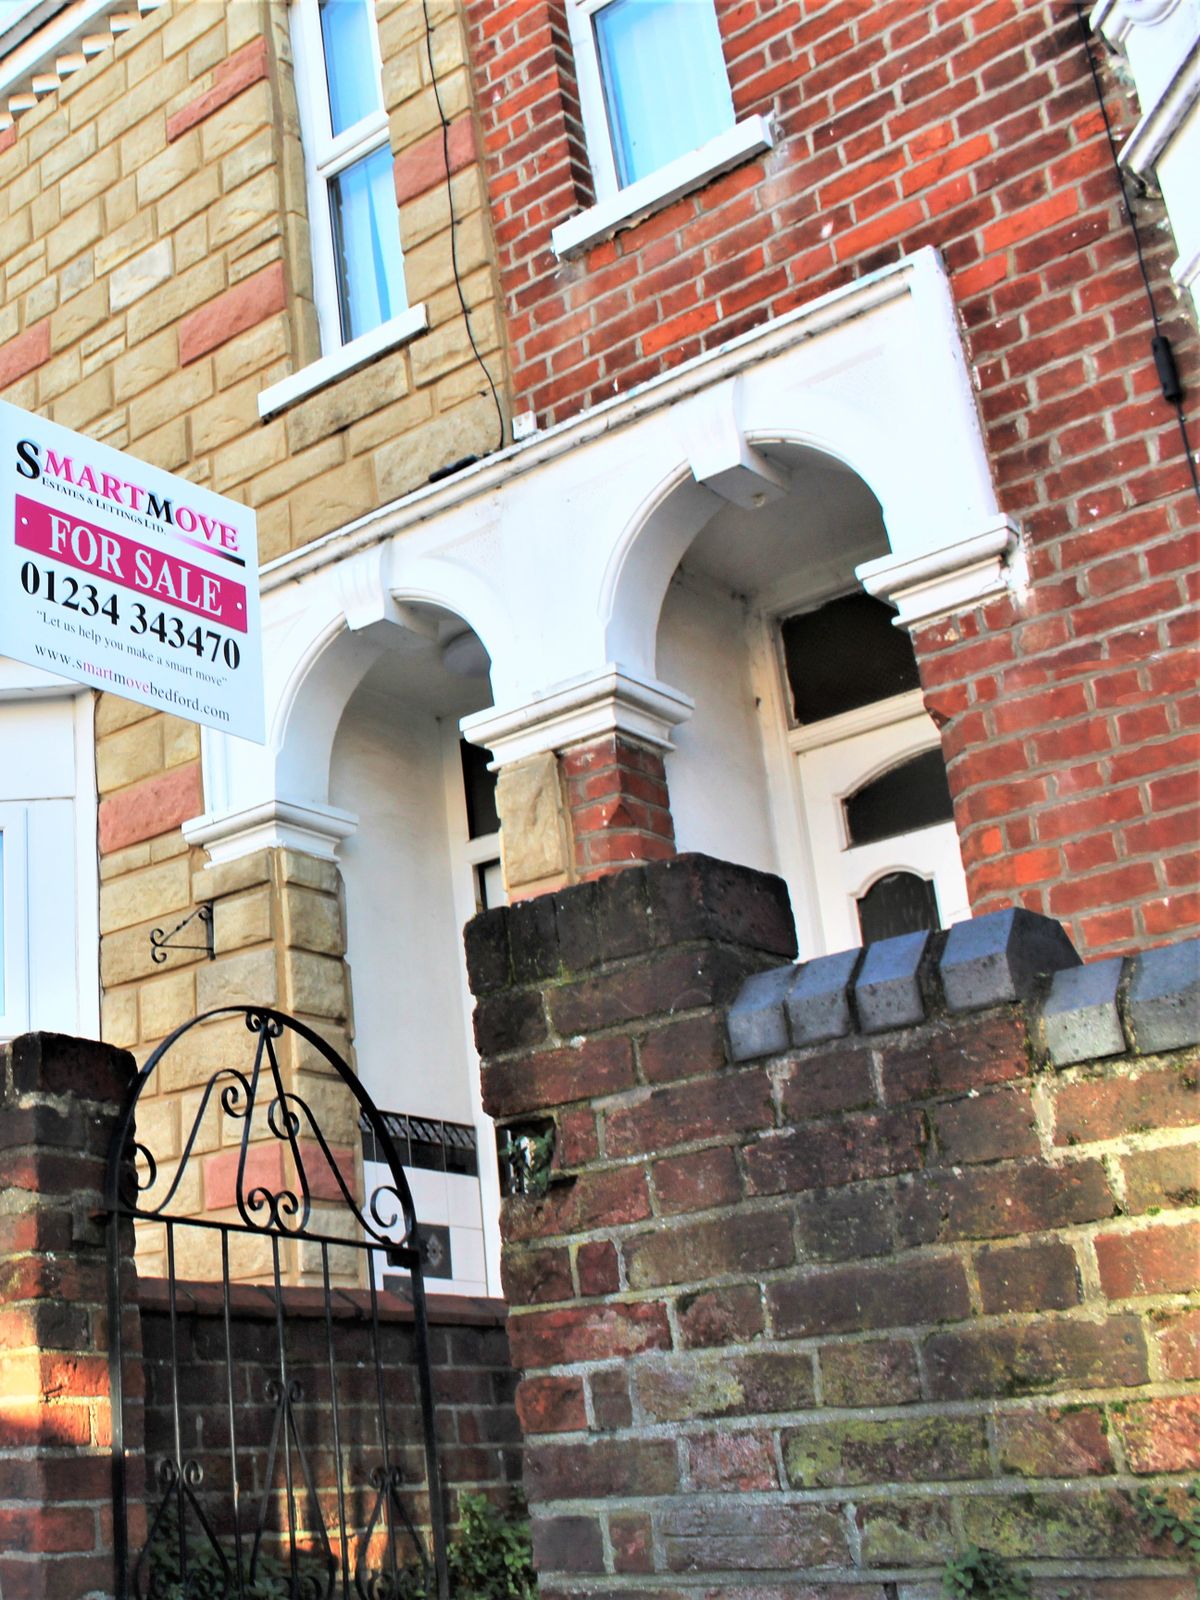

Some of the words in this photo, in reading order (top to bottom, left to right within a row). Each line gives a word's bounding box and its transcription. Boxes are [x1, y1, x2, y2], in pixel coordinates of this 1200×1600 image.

[16, 440, 239, 552] SMARTMOVE
[42, 477, 85, 502] ESTATES
[86, 497, 94, 506] &
[96, 499, 143, 525] LETTINGS
[48, 513, 124, 579] FOR
[135, 549, 222, 617] SALE
[21, 561, 120, 626] 01234
[130, 603, 240, 670] 343470
[64, 619, 76, 633] us
[79, 625, 101, 645] help
[104, 637, 123, 652] you
[127, 644, 154, 662] make
[157, 656, 163, 666] a
[165, 659, 193, 677] smart
[35, 644, 230, 722] www.smartmovebedford.com
